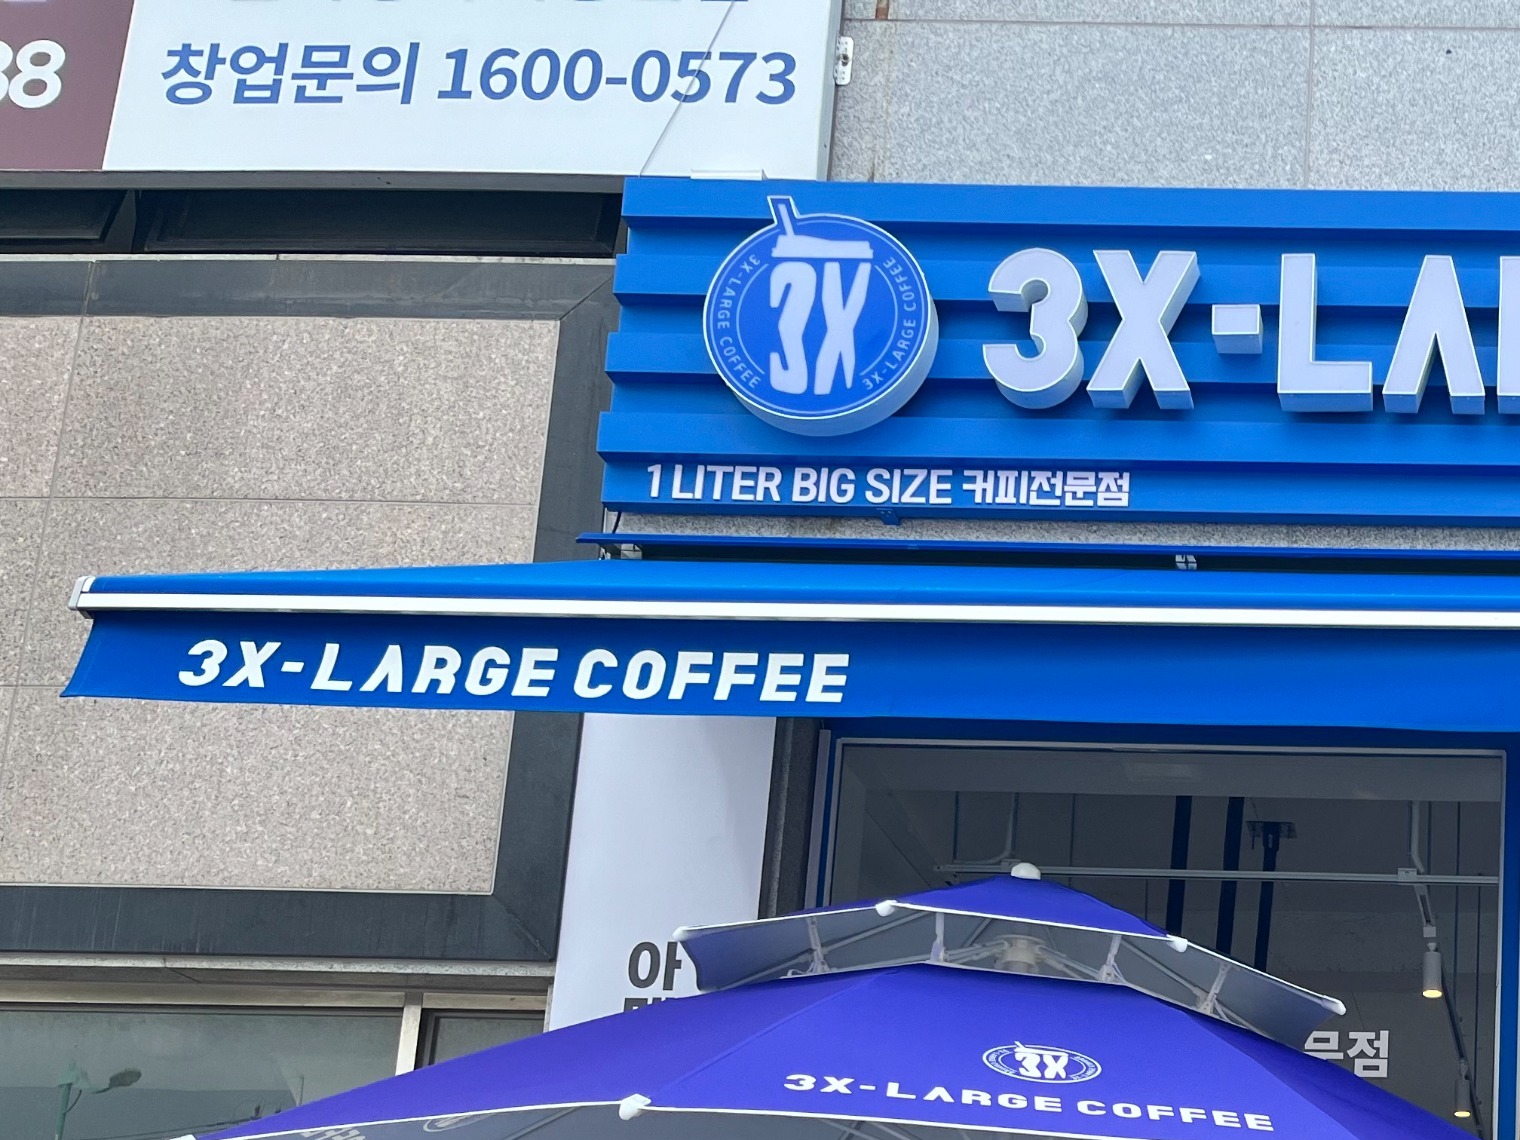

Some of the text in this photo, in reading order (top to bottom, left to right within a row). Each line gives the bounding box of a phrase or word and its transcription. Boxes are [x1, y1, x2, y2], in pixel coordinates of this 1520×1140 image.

[0, 40, 65, 108] 8
[161, 42, 797, 105] 창업문의 1600-0573
[717, 253, 761, 389] 3X-LARGE COFFEE
[769, 260, 871, 395] 3X
[862, 256, 917, 390] 3X-LARGE COFFEE
[647, 463, 1130, 507] 1 LITER BIG SIZE 커피전문점
[178, 639, 850, 703] 3X-LARGE COFFEE
[1014, 1052, 1069, 1079] 3X
[784, 1074, 1275, 1132] 3X-LARGE COFFEE
